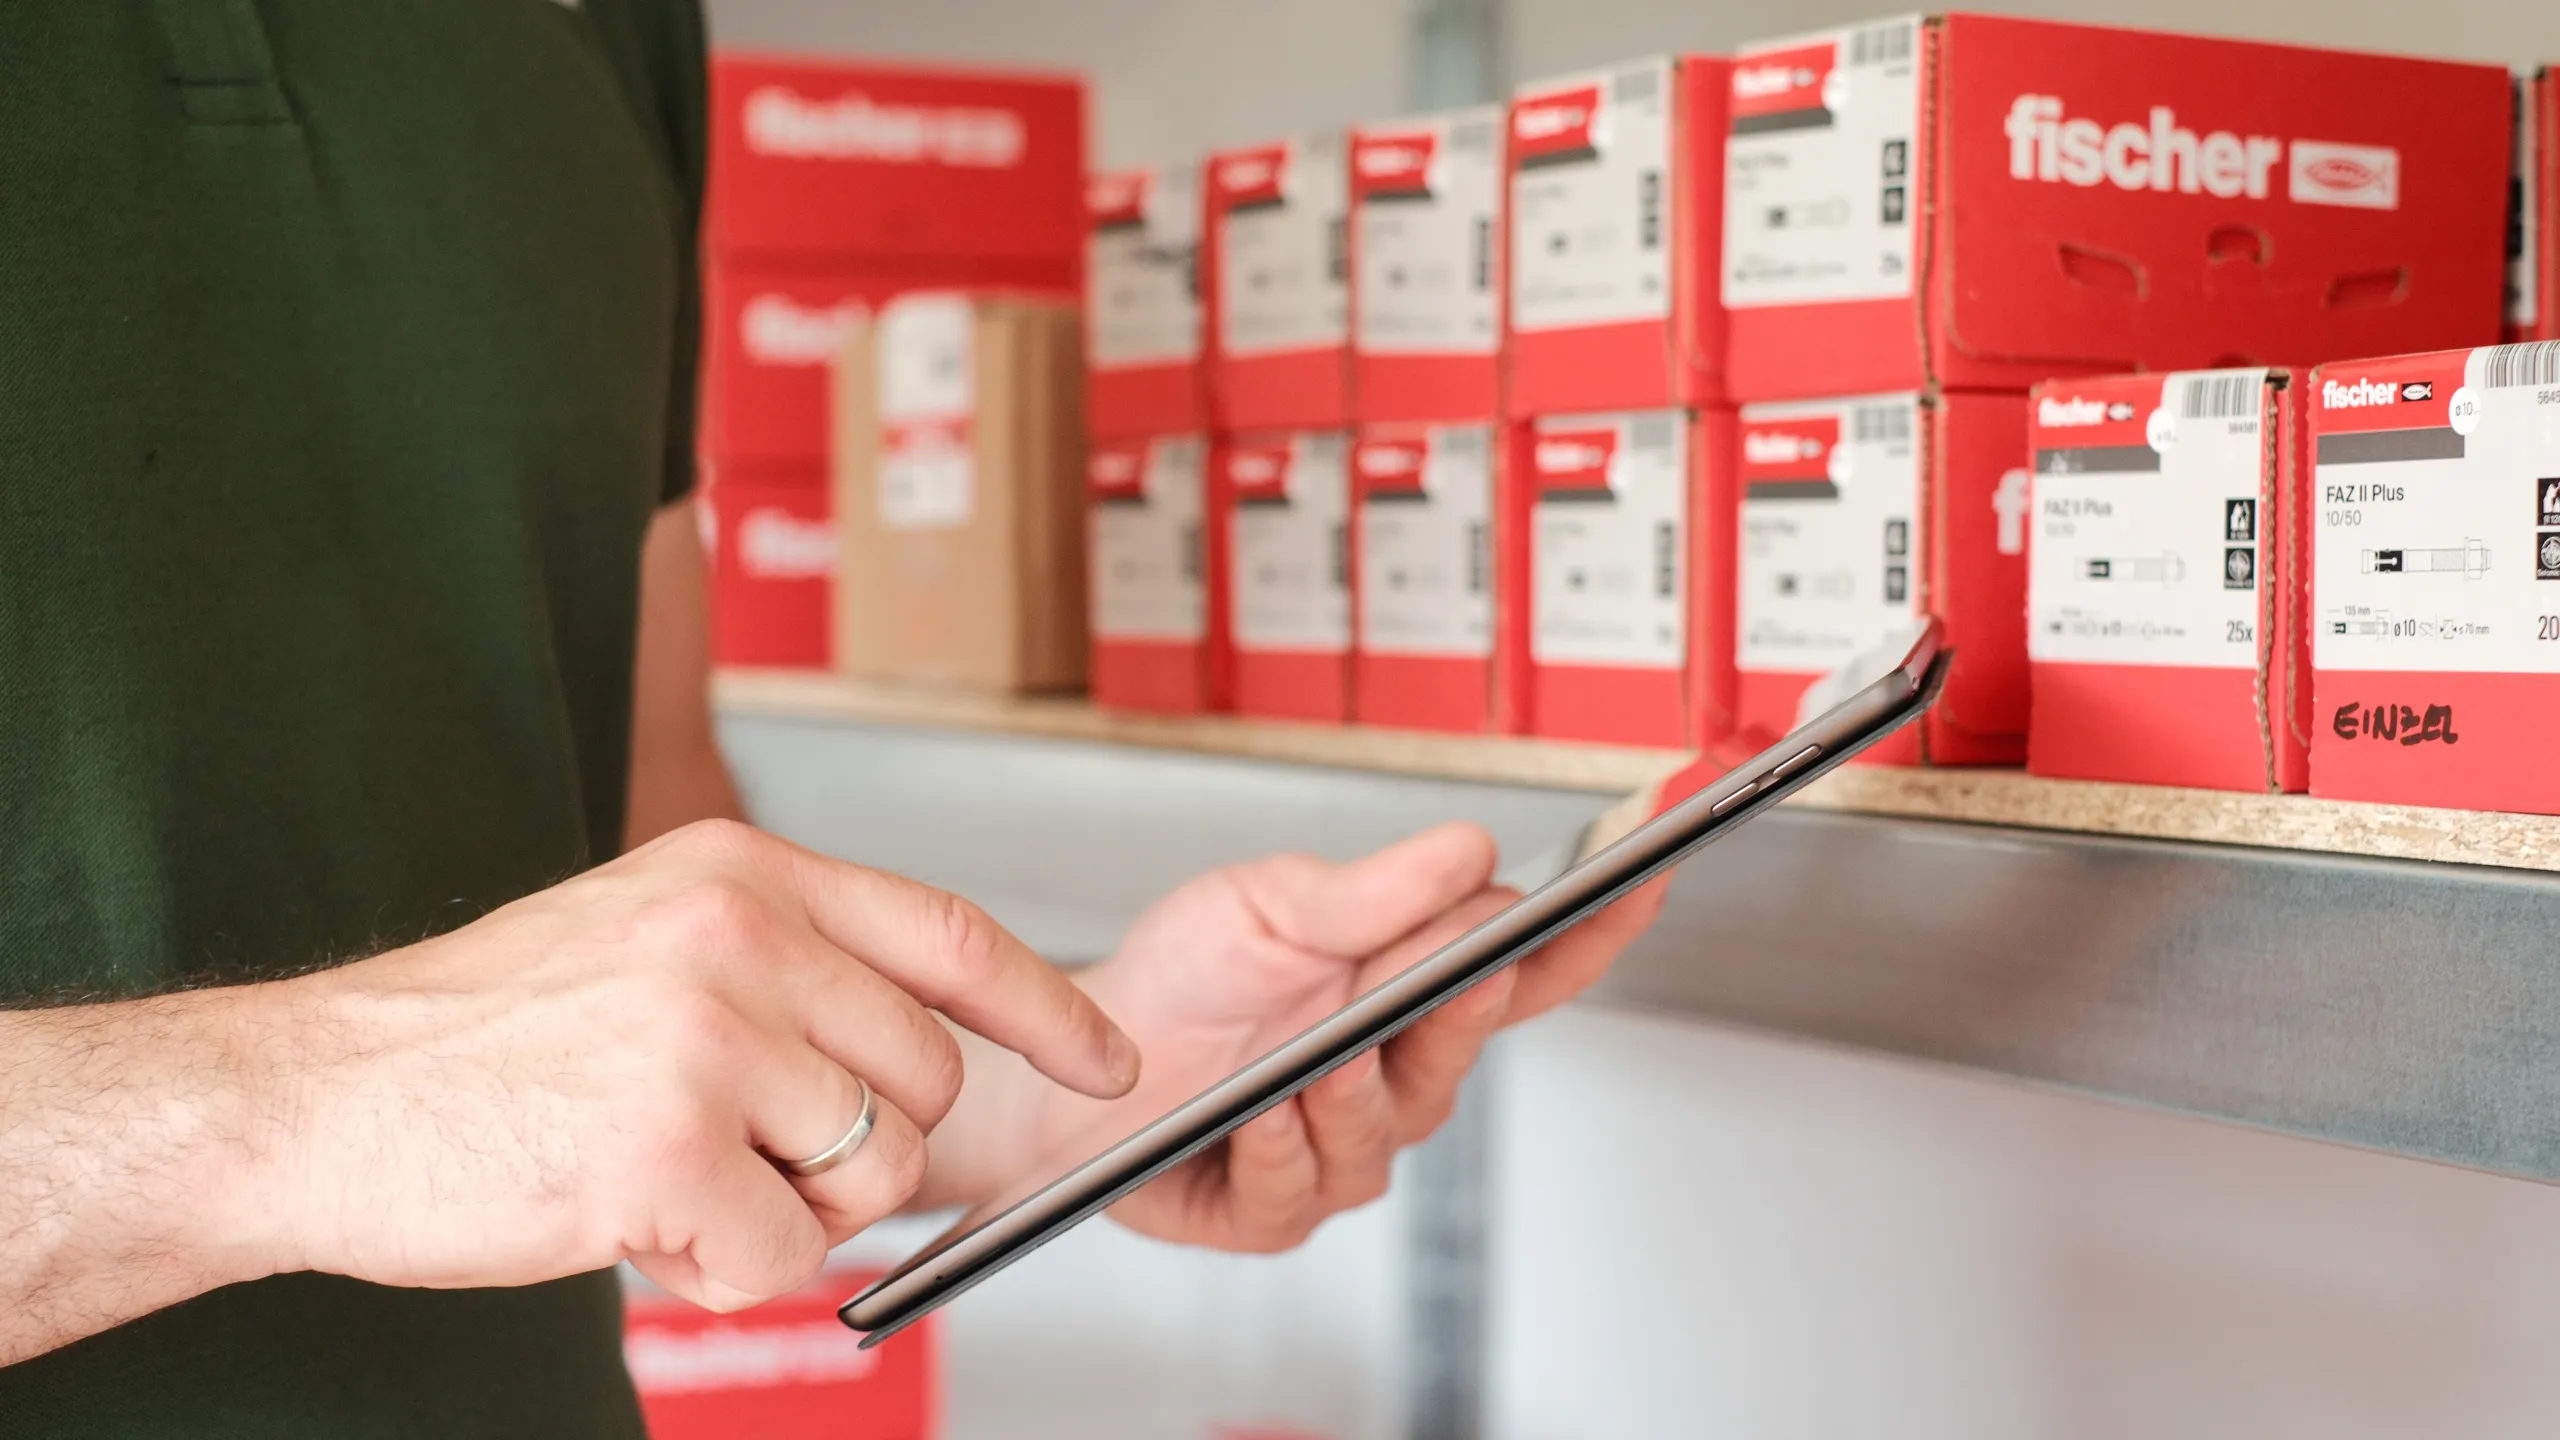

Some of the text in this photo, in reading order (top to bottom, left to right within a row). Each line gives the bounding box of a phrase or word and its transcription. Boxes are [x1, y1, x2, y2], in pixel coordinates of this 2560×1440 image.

[2004, 94, 2281, 199] fischer
[2322, 378, 2398, 409] fischer
[2326, 484, 2404, 503] FAZ II Plus
[2326, 510, 2361, 526] 10/50
[2226, 620, 2253, 643] 25x
